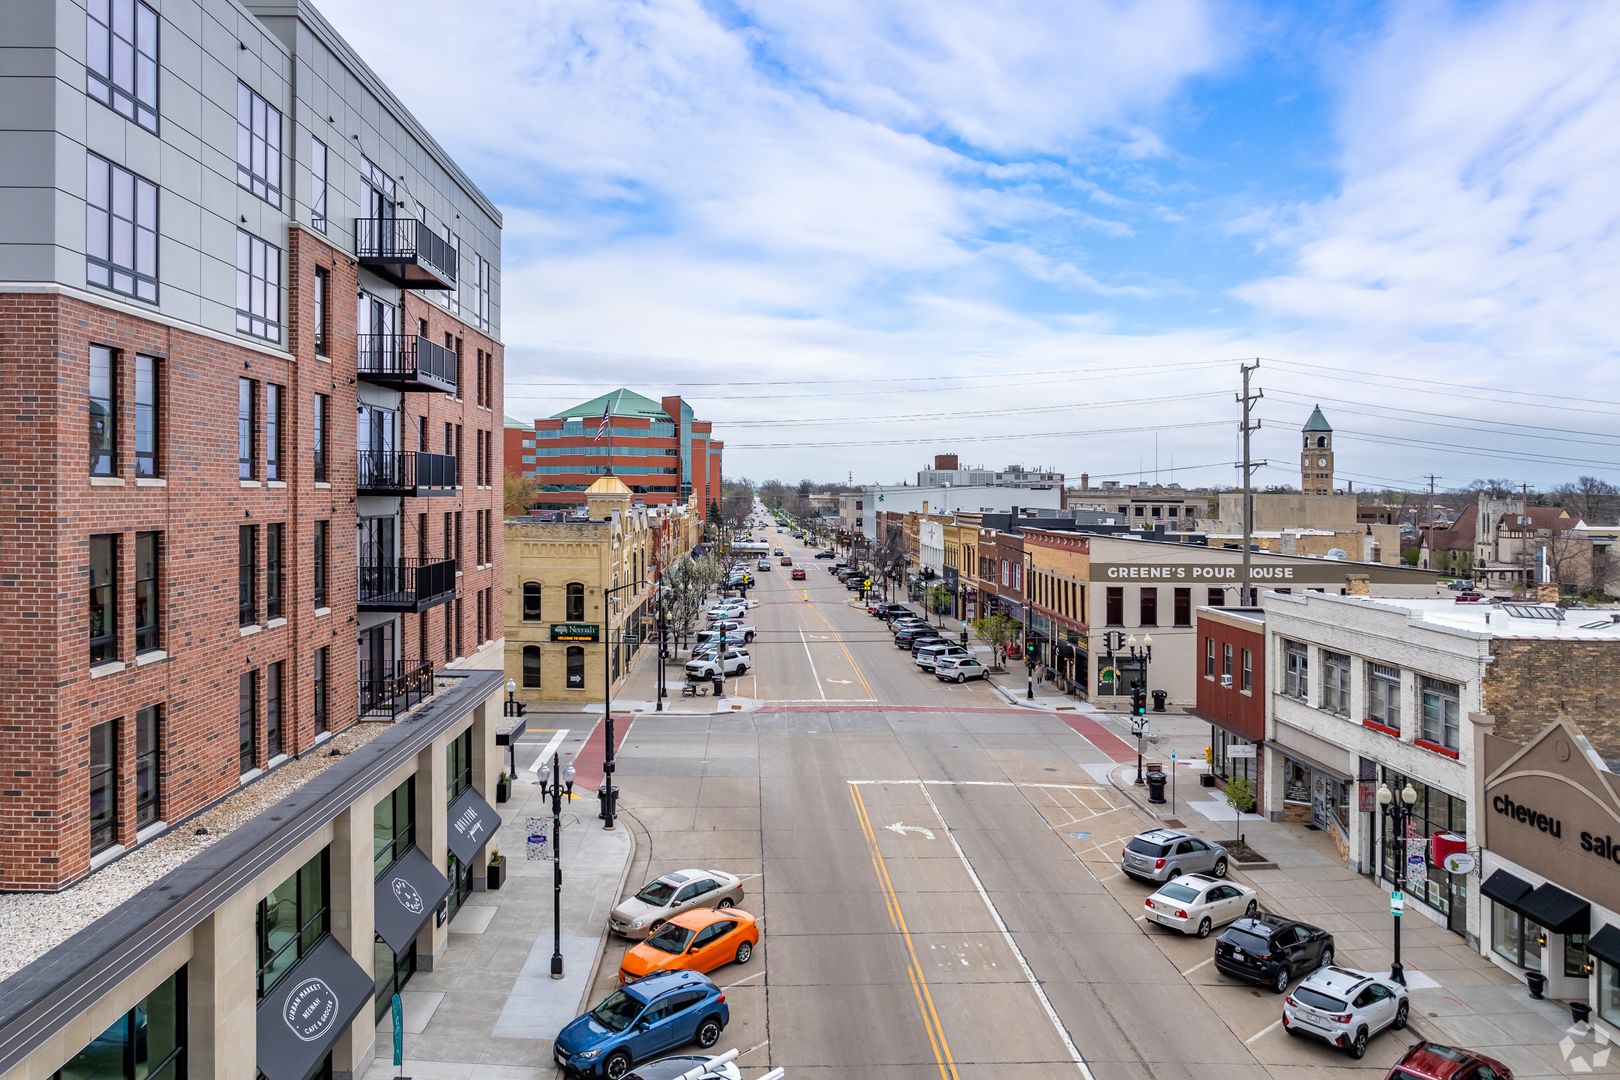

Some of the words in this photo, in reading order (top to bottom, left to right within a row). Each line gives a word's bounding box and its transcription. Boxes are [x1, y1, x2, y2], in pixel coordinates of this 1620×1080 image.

[1107, 567, 1185, 578] GREENE'S
[1193, 567, 1235, 578] POUR
[1493, 794, 1561, 838] cheveu
[289, 997, 301, 1020] URBAN
[299, 983, 321, 999] MARKET
[302, 997, 321, 1019] NEENAH
[304, 1023, 319, 1034] CAFE
[320, 1000, 333, 1022] GROCER
